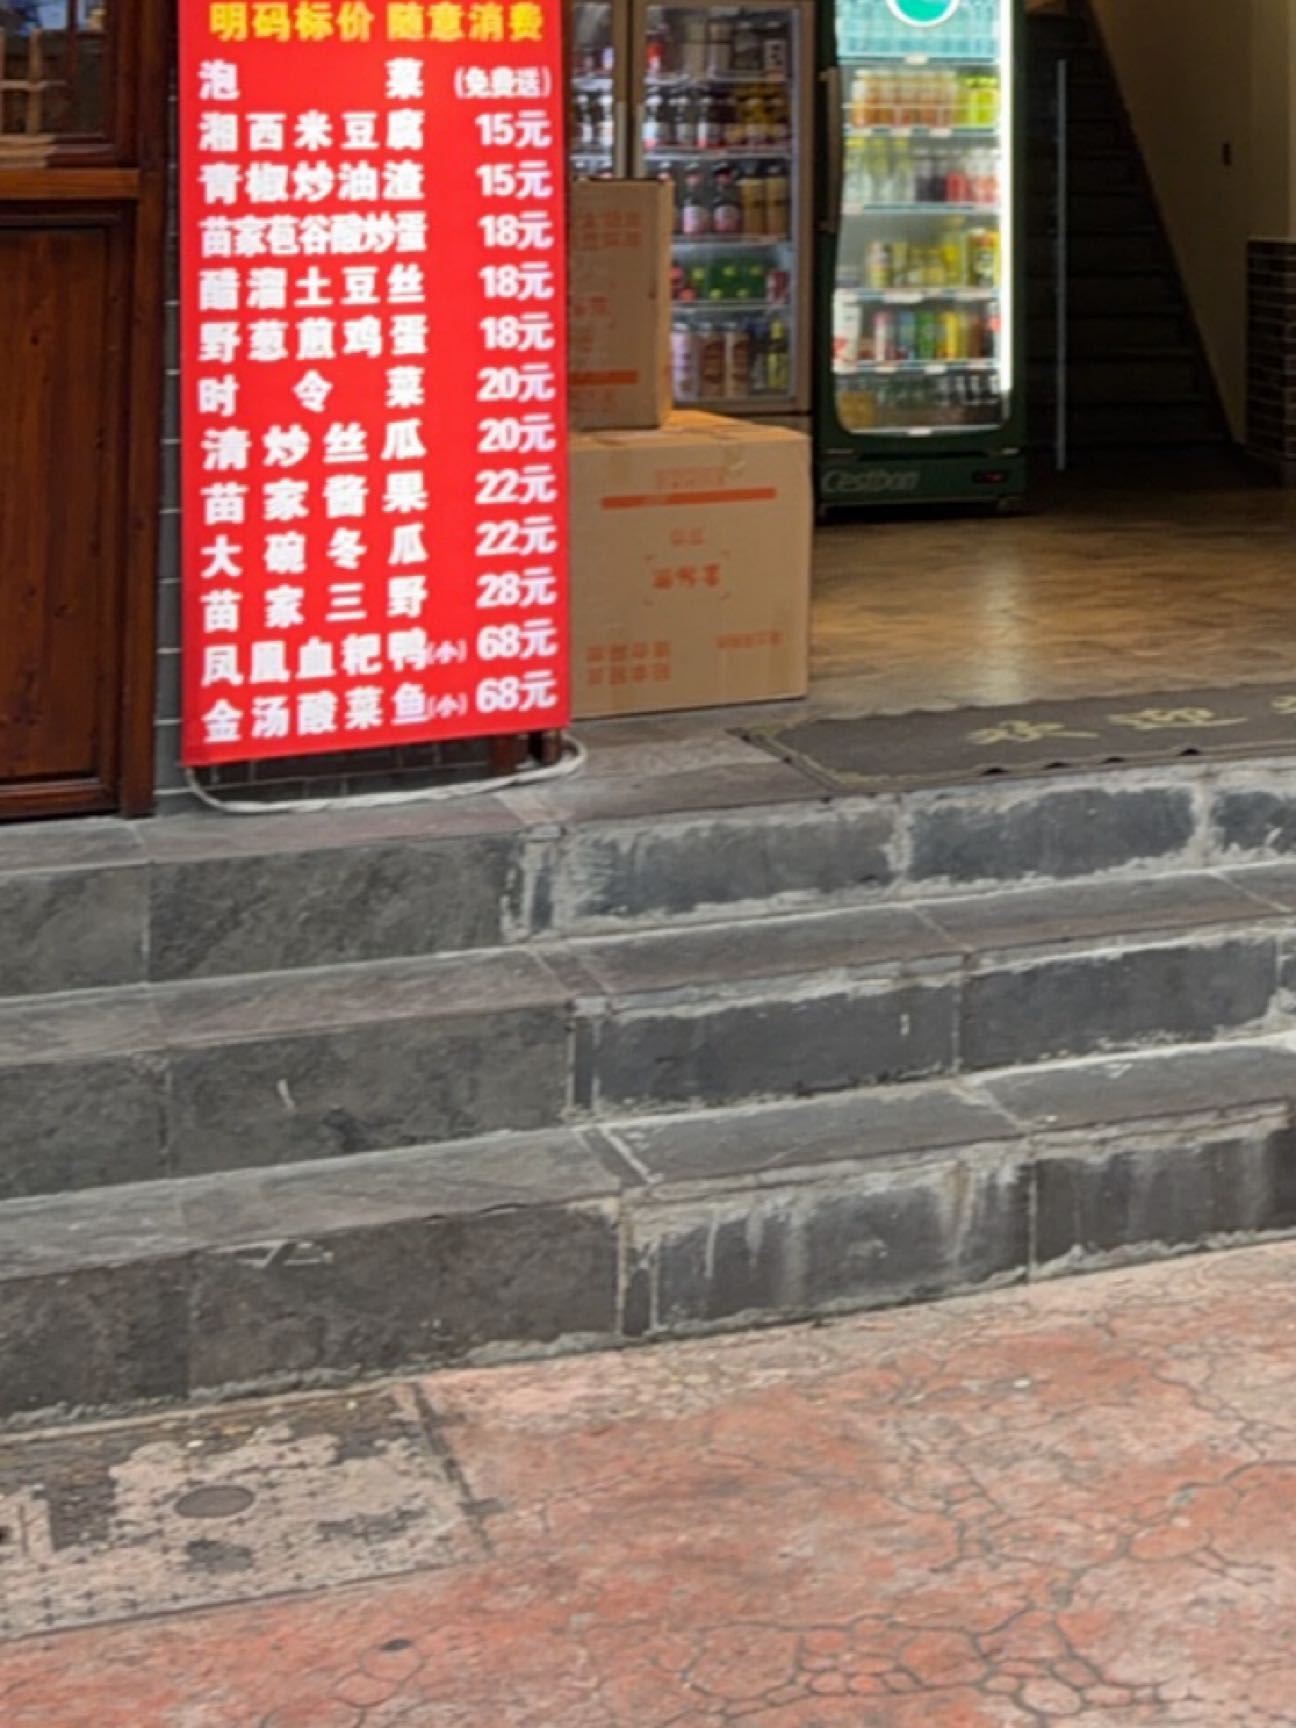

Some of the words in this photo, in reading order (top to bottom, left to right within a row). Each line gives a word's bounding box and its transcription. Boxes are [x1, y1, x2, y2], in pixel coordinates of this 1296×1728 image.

[209, 0, 374, 43] 明码标价
[386, 0, 543, 43] 随意消费
[199, 108, 425, 152] 湘西米豆腐
[475, 110, 552, 148] 15元
[199, 159, 425, 205] 青椒炒油渣
[476, 160, 553, 199] 15元
[479, 211, 554, 250] 18元
[199, 263, 426, 312] 醋溜土豆丝
[479, 261, 555, 301] 18元
[199, 314, 429, 364] 野葱煎鸡蛋
[479, 312, 555, 352] 18元
[198, 365, 425, 418] 时令菜
[476, 363, 556, 403] 20元
[202, 418, 427, 471] 清炒丝瓜
[478, 414, 557, 454] 20元
[475, 465, 557, 505] 22元
[201, 523, 428, 579] 大碗冬瓜
[475, 516, 558, 557] 22元
[201, 575, 428, 634] 苗家三野
[476, 567, 557, 609] 28元
[476, 619, 558, 661] 68元
[476, 669, 557, 714] 68元
